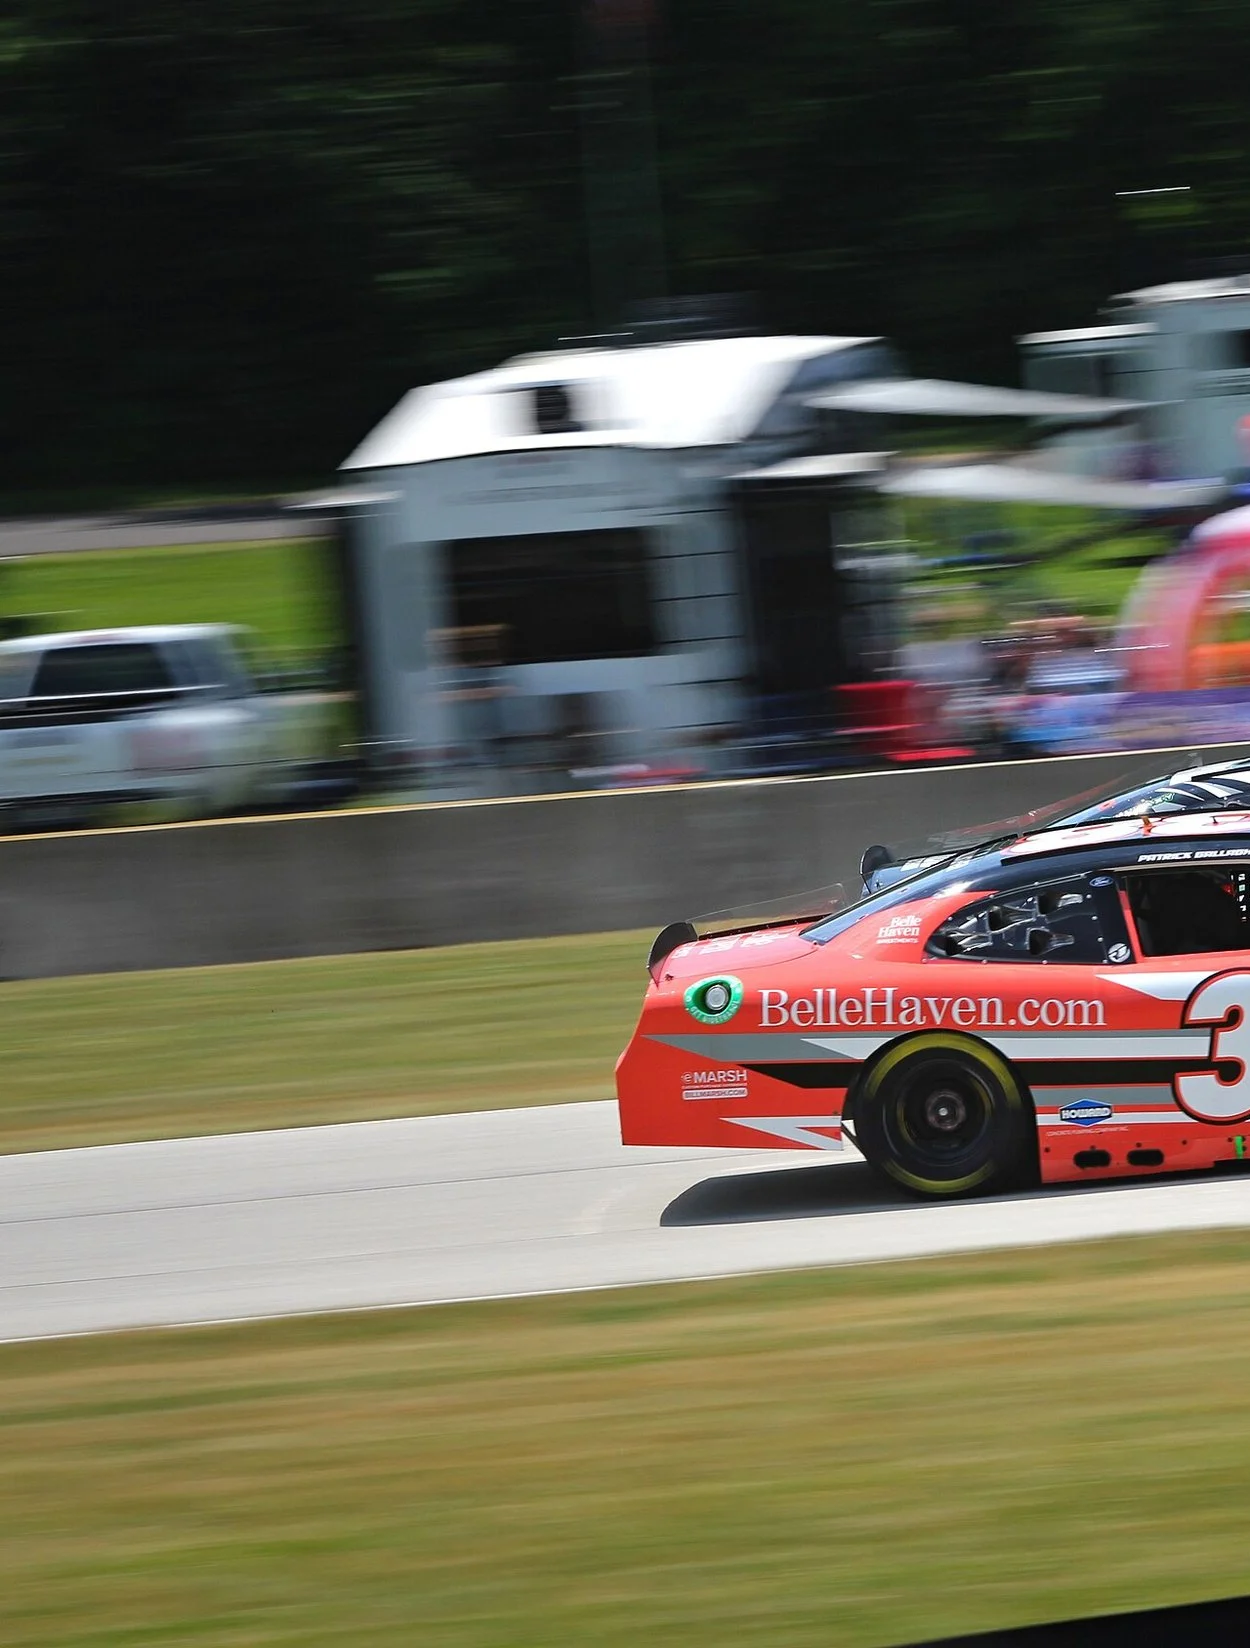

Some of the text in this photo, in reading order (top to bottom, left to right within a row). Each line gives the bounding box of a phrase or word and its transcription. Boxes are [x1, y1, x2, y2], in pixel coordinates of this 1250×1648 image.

[1137, 852, 1193, 862] PATRICK
[890, 915, 922, 927] Belle
[878, 927, 920, 938] Haven
[758, 987, 1108, 1027] BelleHaven.com
